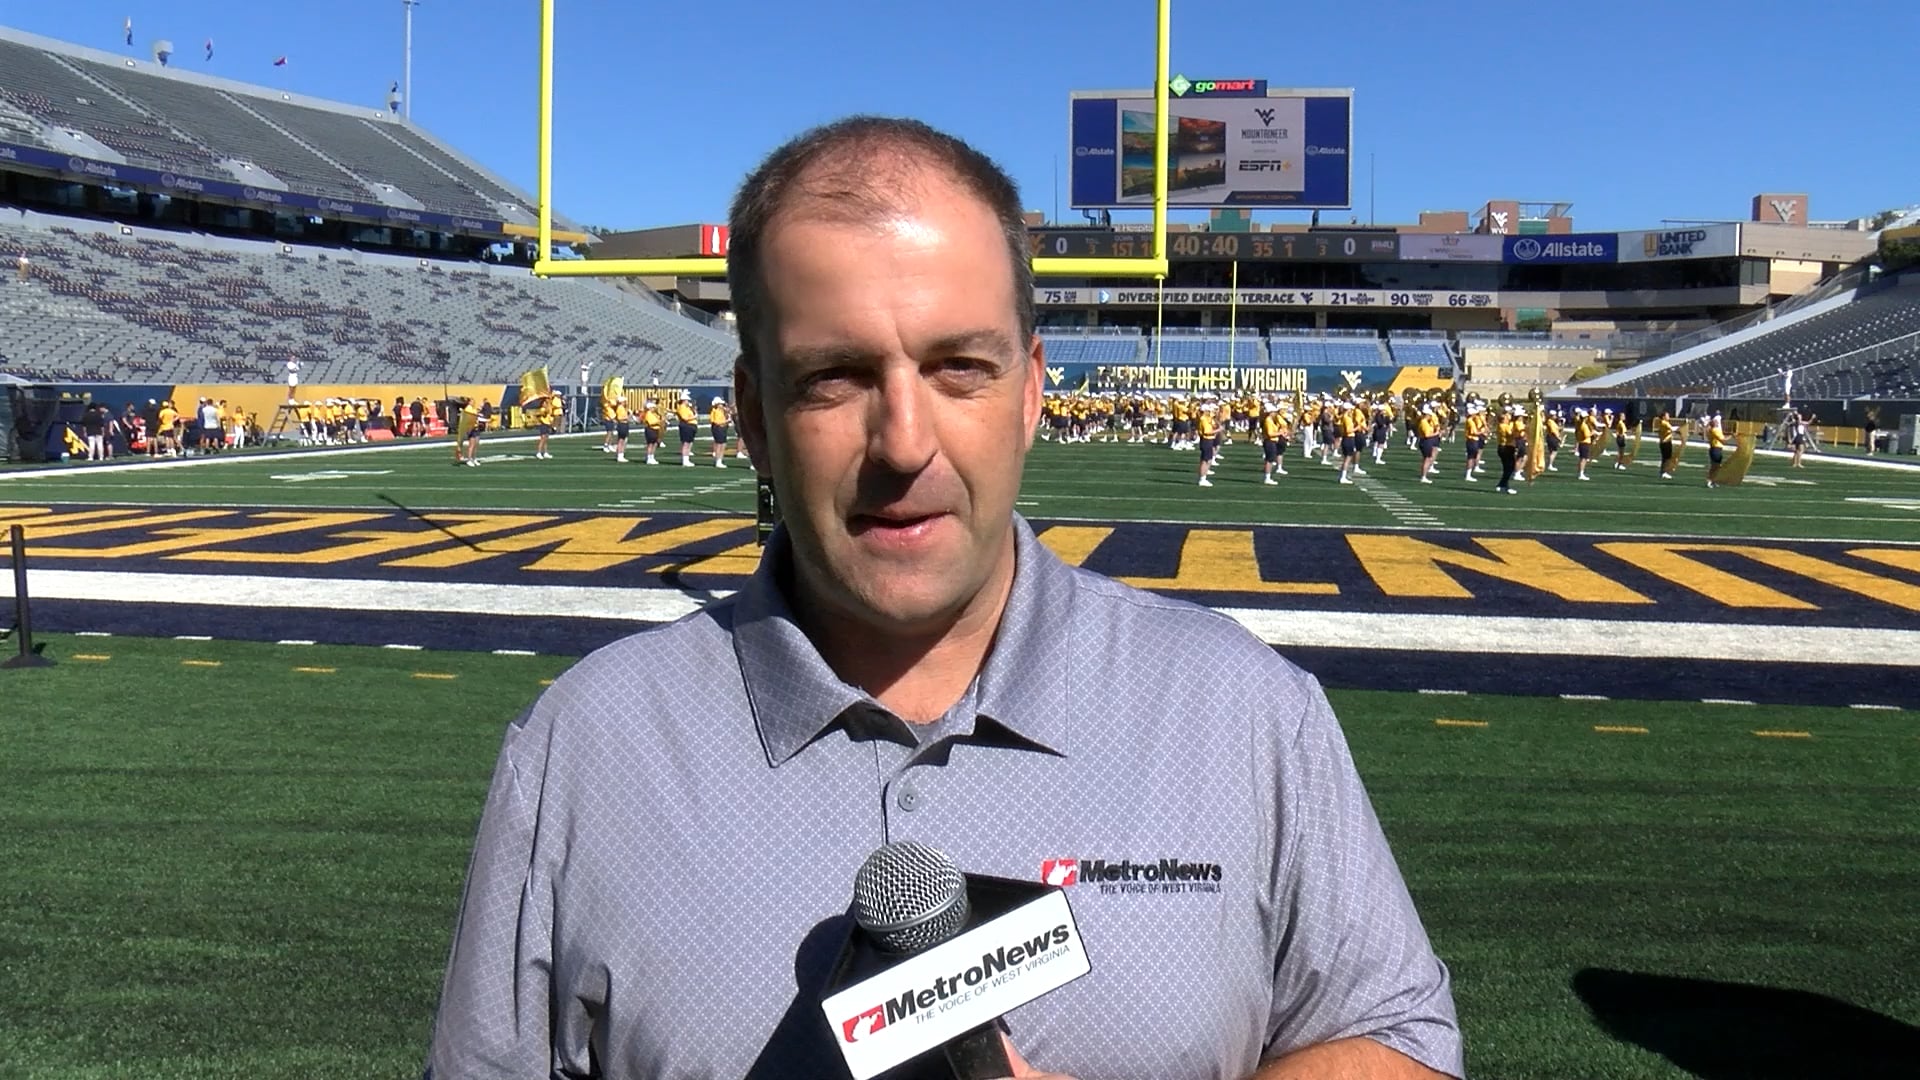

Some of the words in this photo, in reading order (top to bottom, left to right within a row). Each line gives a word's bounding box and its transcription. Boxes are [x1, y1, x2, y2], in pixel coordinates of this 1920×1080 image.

[1195, 80, 1255, 93] gomart
[1491, 227, 1508, 235] WVU
[1660, 230, 1707, 243] UNITED
[1056, 237, 1068, 254] 0
[1112, 242, 1134, 256] 1ST
[1173, 234, 1238, 256] 40:40
[1253, 242, 1273, 257] 35
[1285, 243, 1293, 257] 1
[1344, 237, 1356, 256] 0
[1541, 241, 1604, 257] Allstate
[1659, 242, 1694, 256] BANK
[1045, 291, 1061, 303] 75
[1118, 292, 1189, 303] DIVERSFIED
[1241, 293, 1295, 304] TERRACE
[1331, 293, 1348, 305] 21
[1391, 293, 1409, 306] 90
[1448, 294, 1467, 306] 66
[1177, 366, 1196, 390] OF
[1199, 367, 1237, 390] WEST
[1241, 368, 1308, 391] VIRGINIA
[1079, 858, 1223, 883] MetroNews
[1101, 884, 1117, 895] THE
[1121, 884, 1147, 894] VOICE
[1150, 884, 1160, 894] OF
[1162, 884, 1187, 894] WEST
[885, 924, 1070, 1026] MetroNews
[915, 1010, 936, 1025] THE
[939, 991, 972, 1014] VOICE
[974, 983, 989, 996] OF
[993, 967, 1024, 989] WEST
[1025, 945, 1071, 972] VIRGINIA
